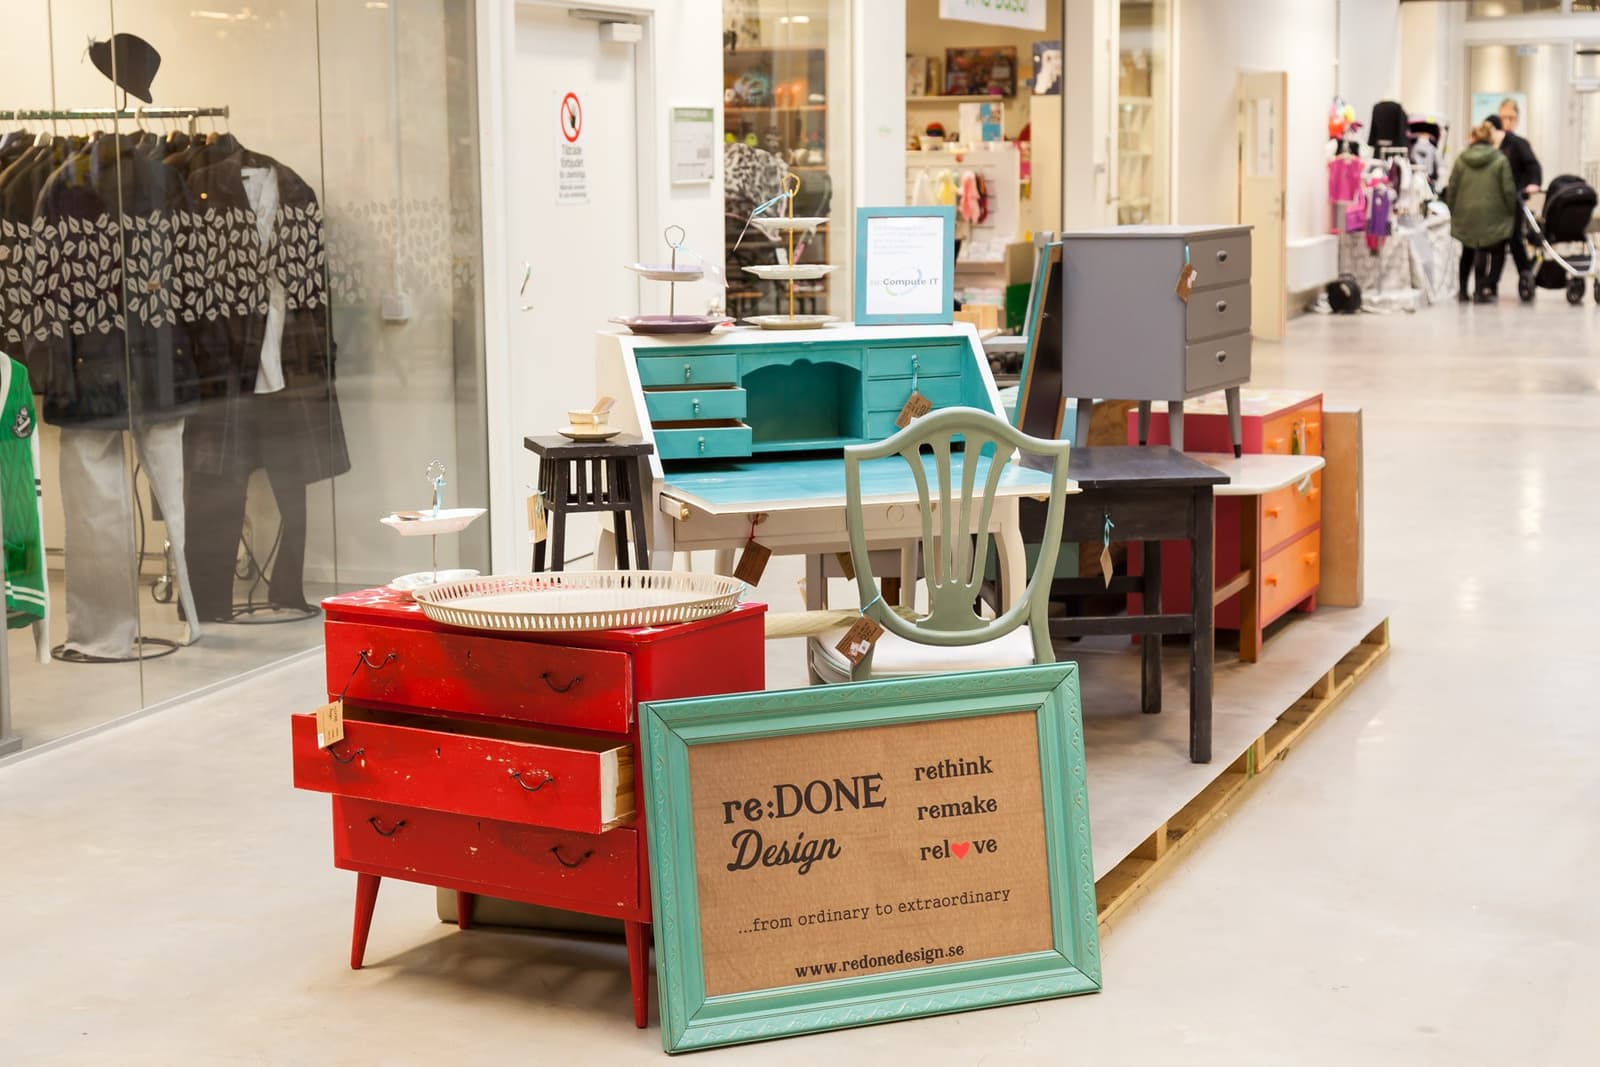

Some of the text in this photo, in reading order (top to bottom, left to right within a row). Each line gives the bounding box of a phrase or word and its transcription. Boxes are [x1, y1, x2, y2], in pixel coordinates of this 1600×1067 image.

[914, 756, 993, 781] rethink
[722, 772, 887, 825] re:DONE
[917, 794, 998, 820] remake
[726, 828, 842, 875] Design
[797, 905, 869, 926] ordinary
[875, 901, 893, 917] to
[897, 888, 1011, 914] extraordinary
[794, 944, 965, 979] www.redonedesign.se
